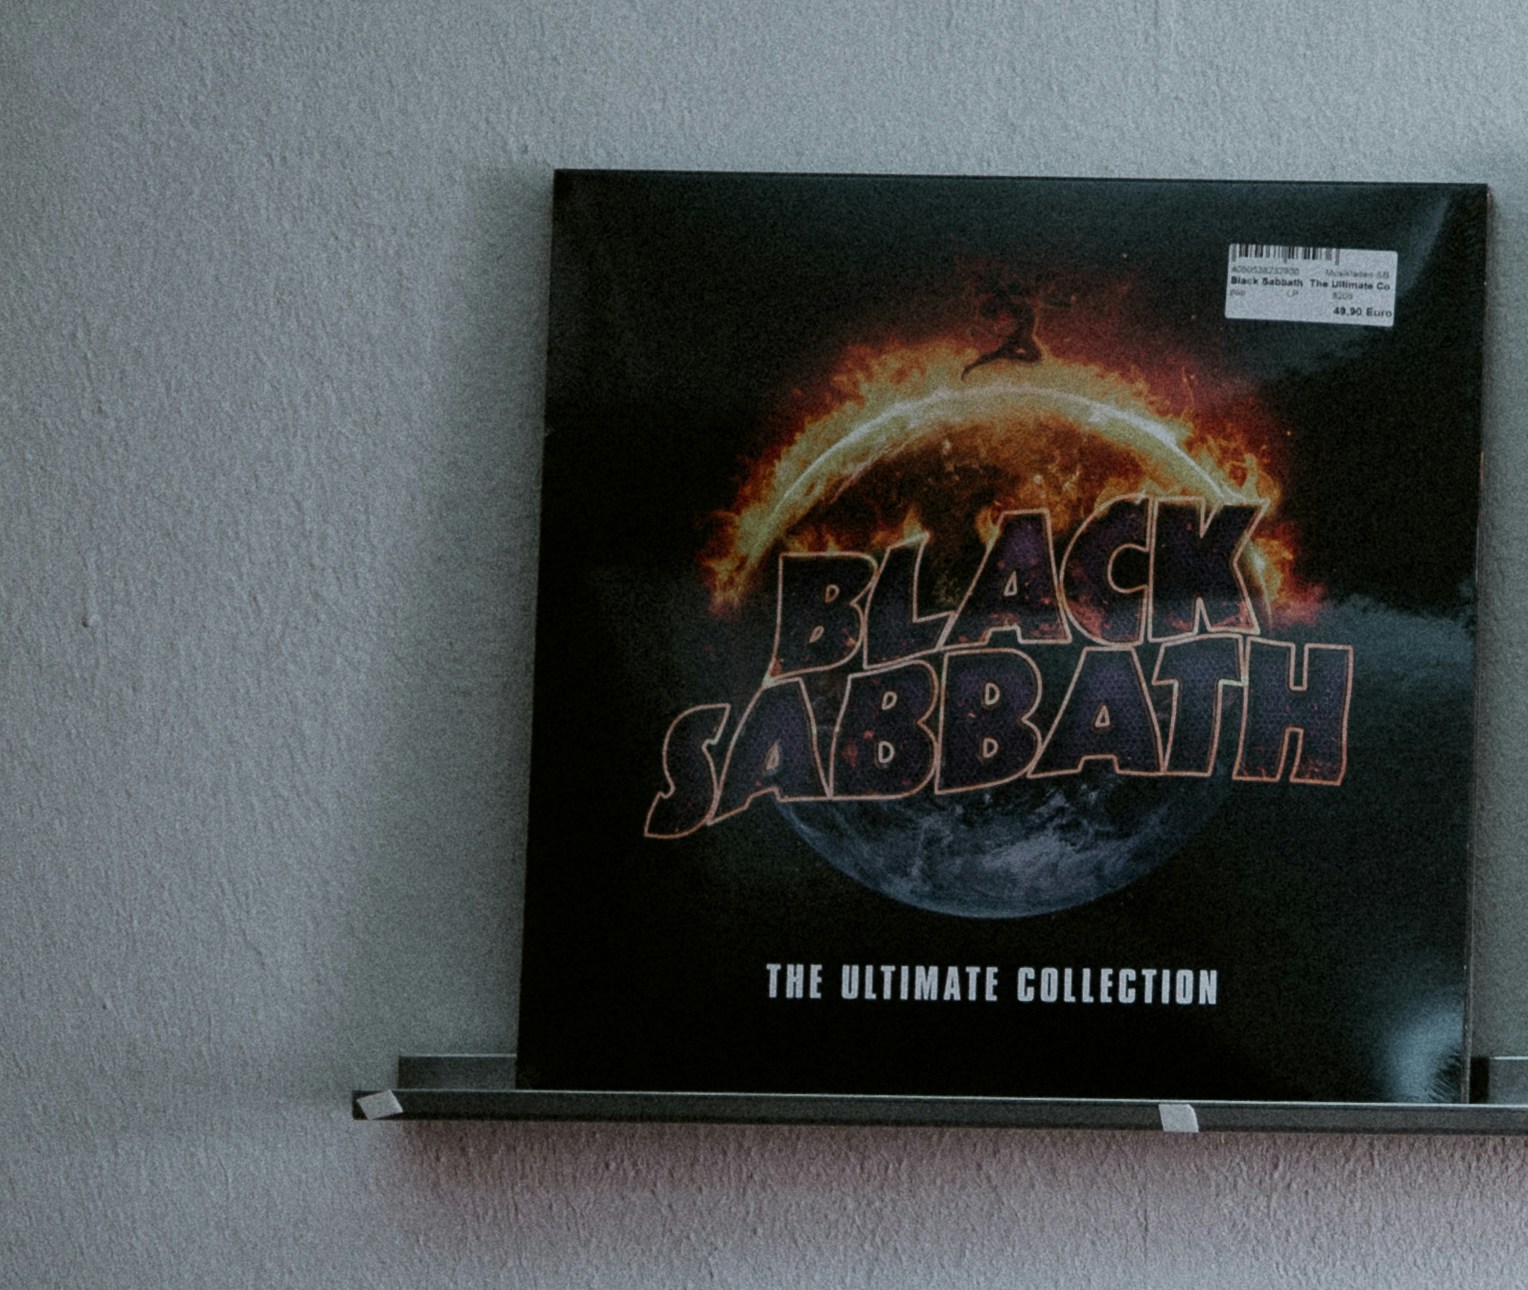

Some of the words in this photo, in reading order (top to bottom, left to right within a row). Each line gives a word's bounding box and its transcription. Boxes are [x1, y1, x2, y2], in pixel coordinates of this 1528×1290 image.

[1231, 276, 1258, 285] Black
[1262, 277, 1303, 287] Sabbath
[1310, 279, 1328, 288] The
[1332, 280, 1373, 290] Ultimate
[1376, 282, 1390, 291] Co
[1366, 308, 1392, 318] Euro
[762, 494, 1270, 686] BLACK
[643, 630, 1355, 839] SABBATH
[766, 961, 823, 1001] THE
[841, 963, 999, 1003] ULTIMATE
[1016, 966, 1219, 1006] COLLECTION
